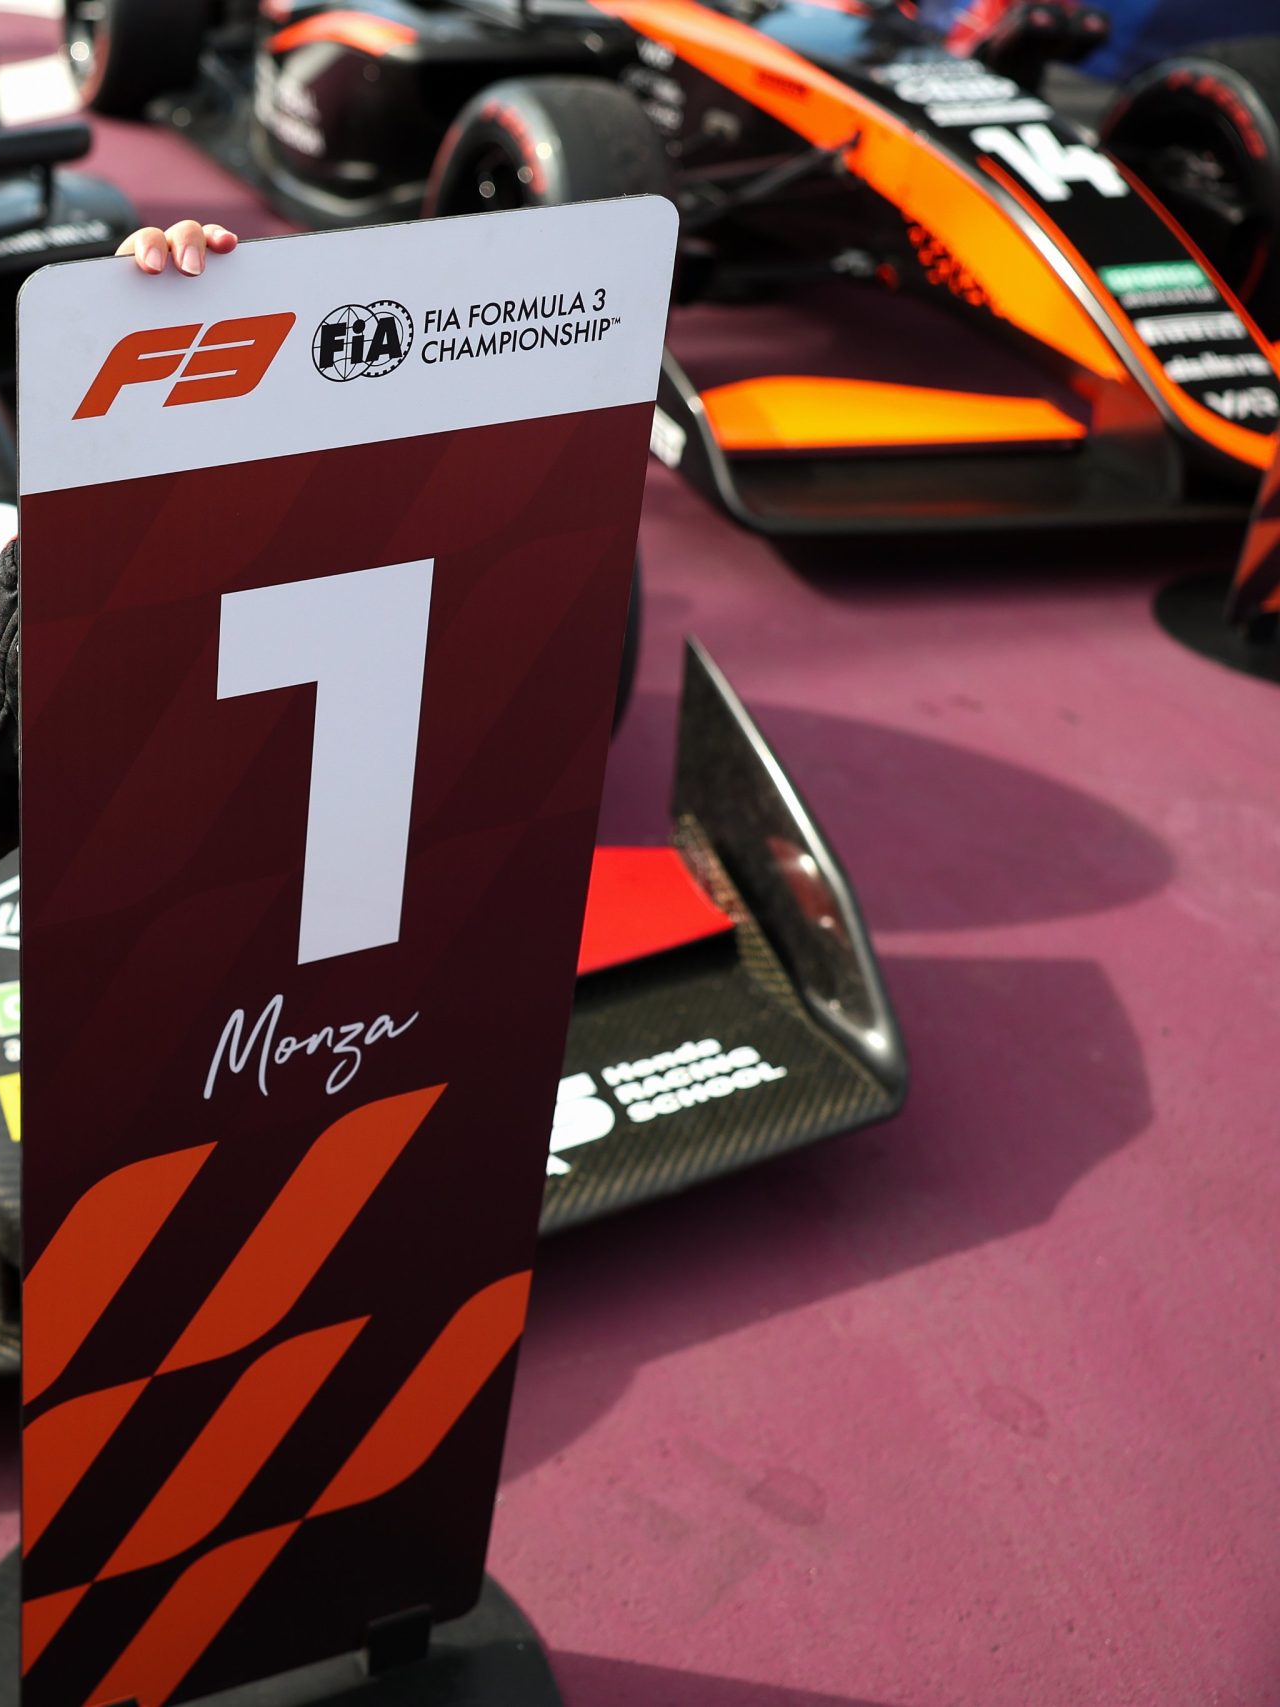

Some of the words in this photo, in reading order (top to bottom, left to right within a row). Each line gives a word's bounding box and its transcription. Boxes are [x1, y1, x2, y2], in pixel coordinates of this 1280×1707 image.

[969, 123, 1129, 202] 14
[424, 307, 461, 334] FIA
[468, 291, 586, 328] FORMULA
[592, 288, 606, 311] 3
[72, 312, 296, 420] F3
[217, 558, 434, 964] 1
[204, 994, 419, 1098] Monza
